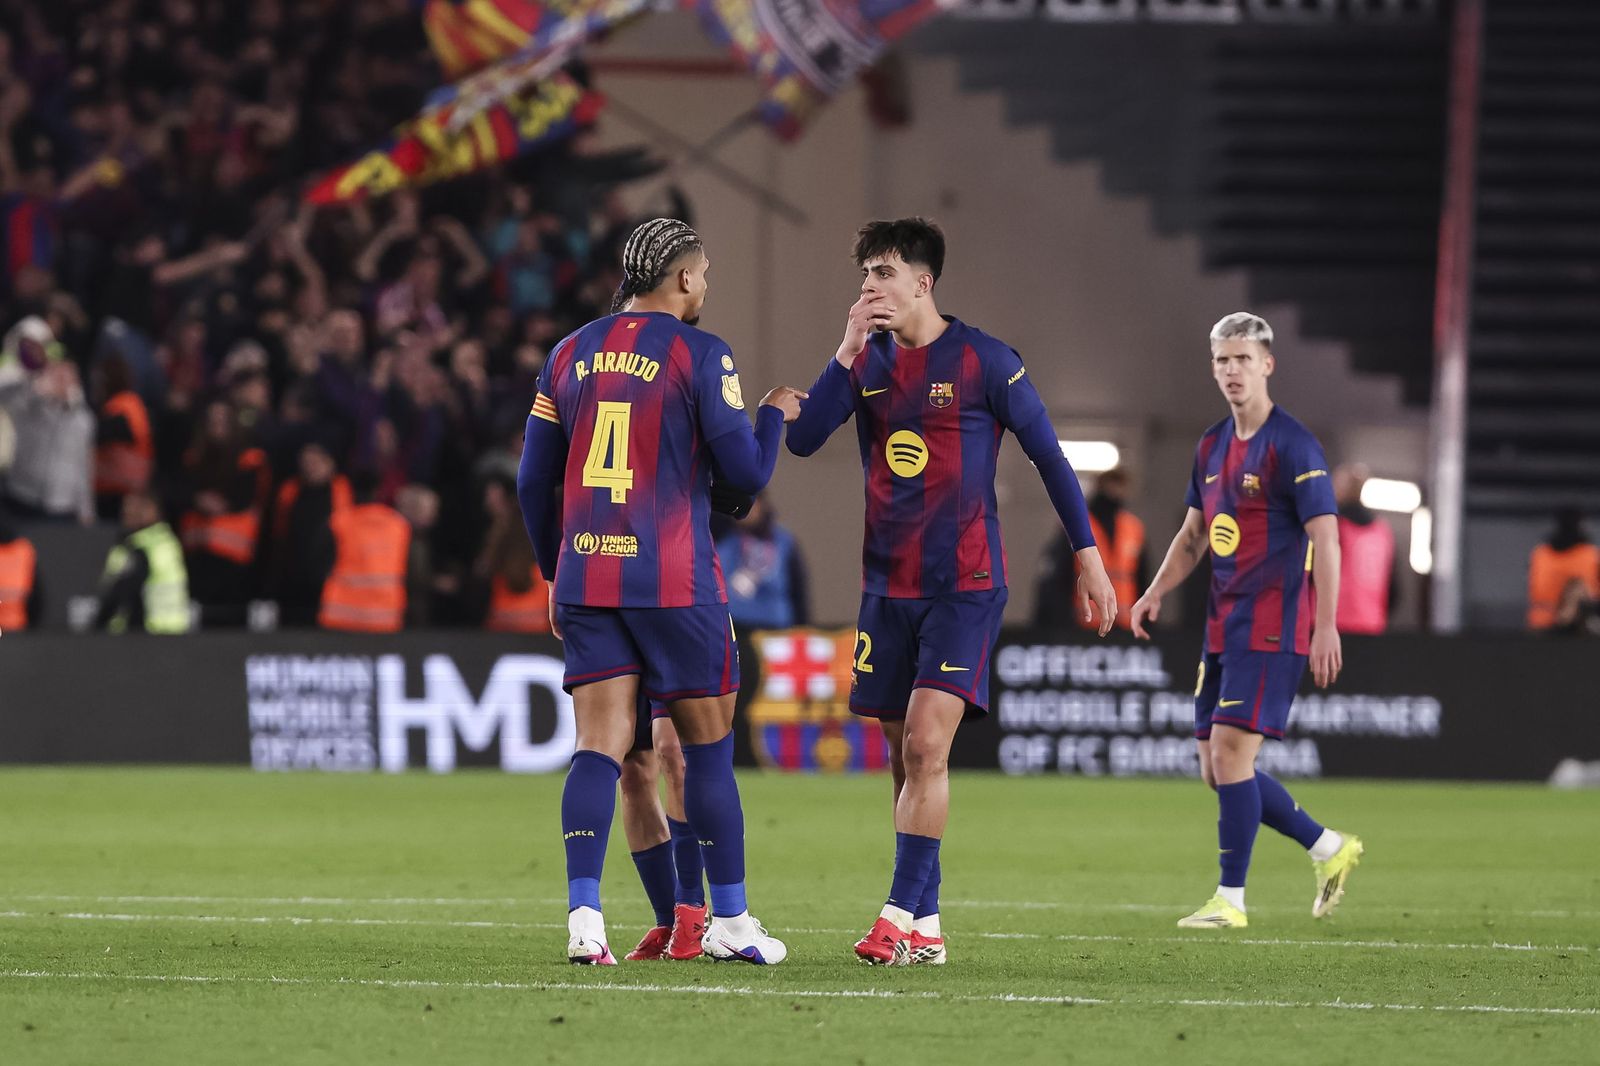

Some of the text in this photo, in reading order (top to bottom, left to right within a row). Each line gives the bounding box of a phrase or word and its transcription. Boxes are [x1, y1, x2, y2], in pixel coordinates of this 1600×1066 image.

[575, 351, 660, 383] R. ARAUJO
[582, 401, 633, 503] 4
[600, 543, 638, 554] ACNUR
[601, 534, 638, 545] UNHCR
[246, 655, 373, 691] HUMAN
[997, 645, 1168, 686] OFFICIAL
[374, 653, 576, 774] HMD
[999, 690, 1145, 732] MOBILE
[1000, 735, 1052, 776] OF
[1057, 735, 1106, 776] FC
